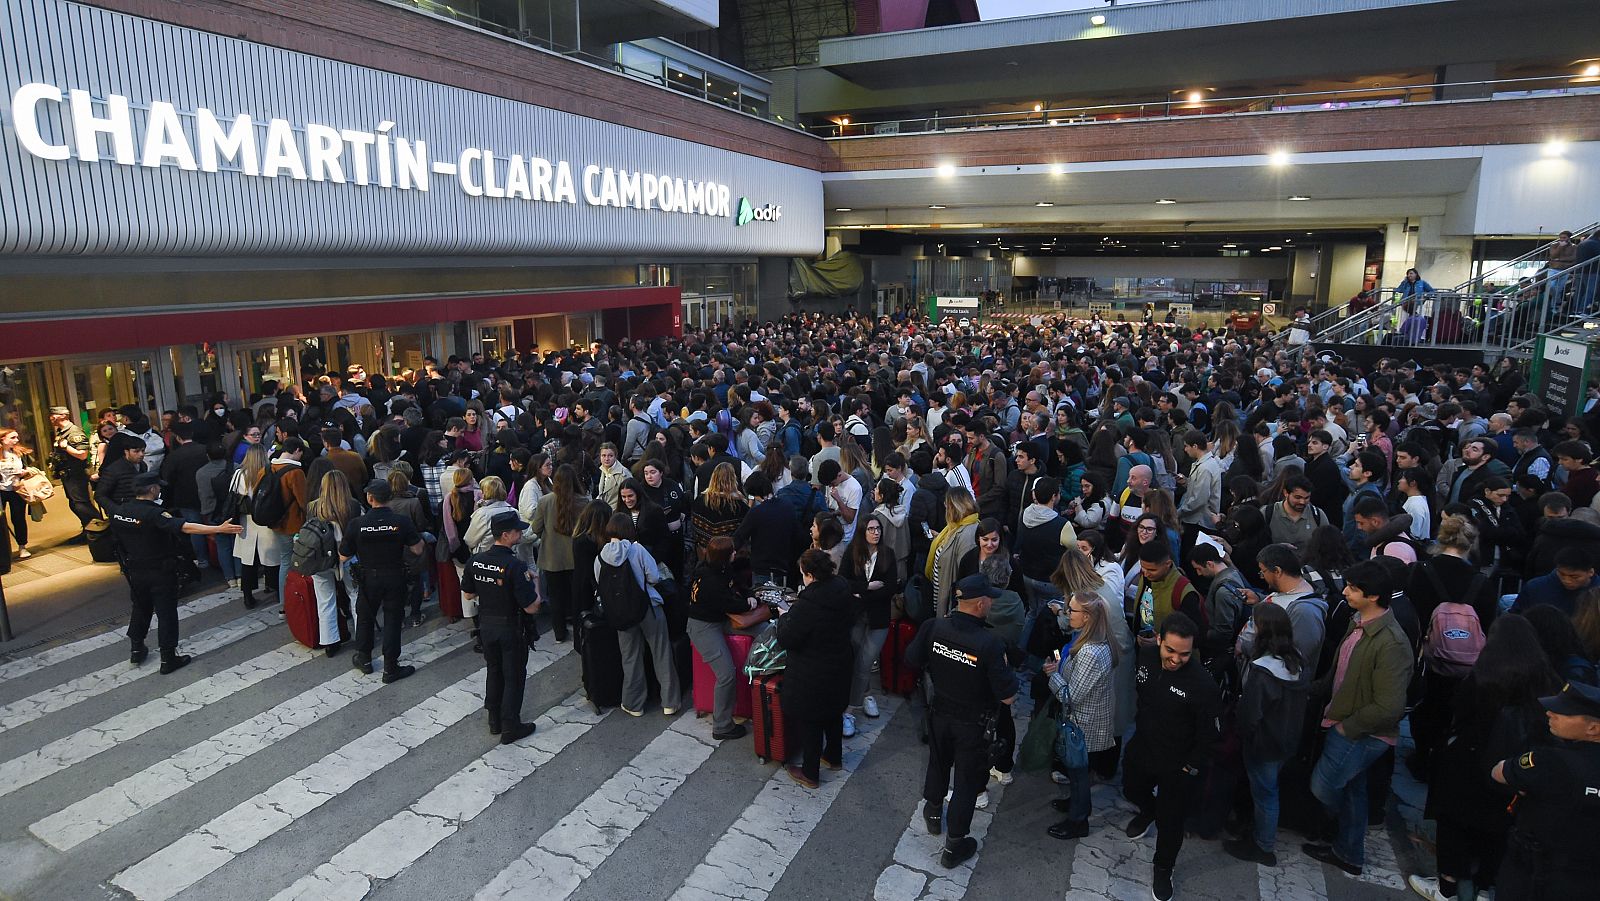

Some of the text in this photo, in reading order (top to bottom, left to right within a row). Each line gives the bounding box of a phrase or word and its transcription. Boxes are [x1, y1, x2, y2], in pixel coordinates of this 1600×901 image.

[583, 164, 731, 217] CAMPOAMOR
[753, 203, 782, 221] adif
[1559, 347, 1571, 355] adif
[113, 514, 137, 523] POLICIA
[472, 561, 500, 573] POLICIA
[932, 647, 977, 668] NACIONAL
[933, 641, 968, 659] POLICIA
[1169, 685, 1186, 698] NASA
